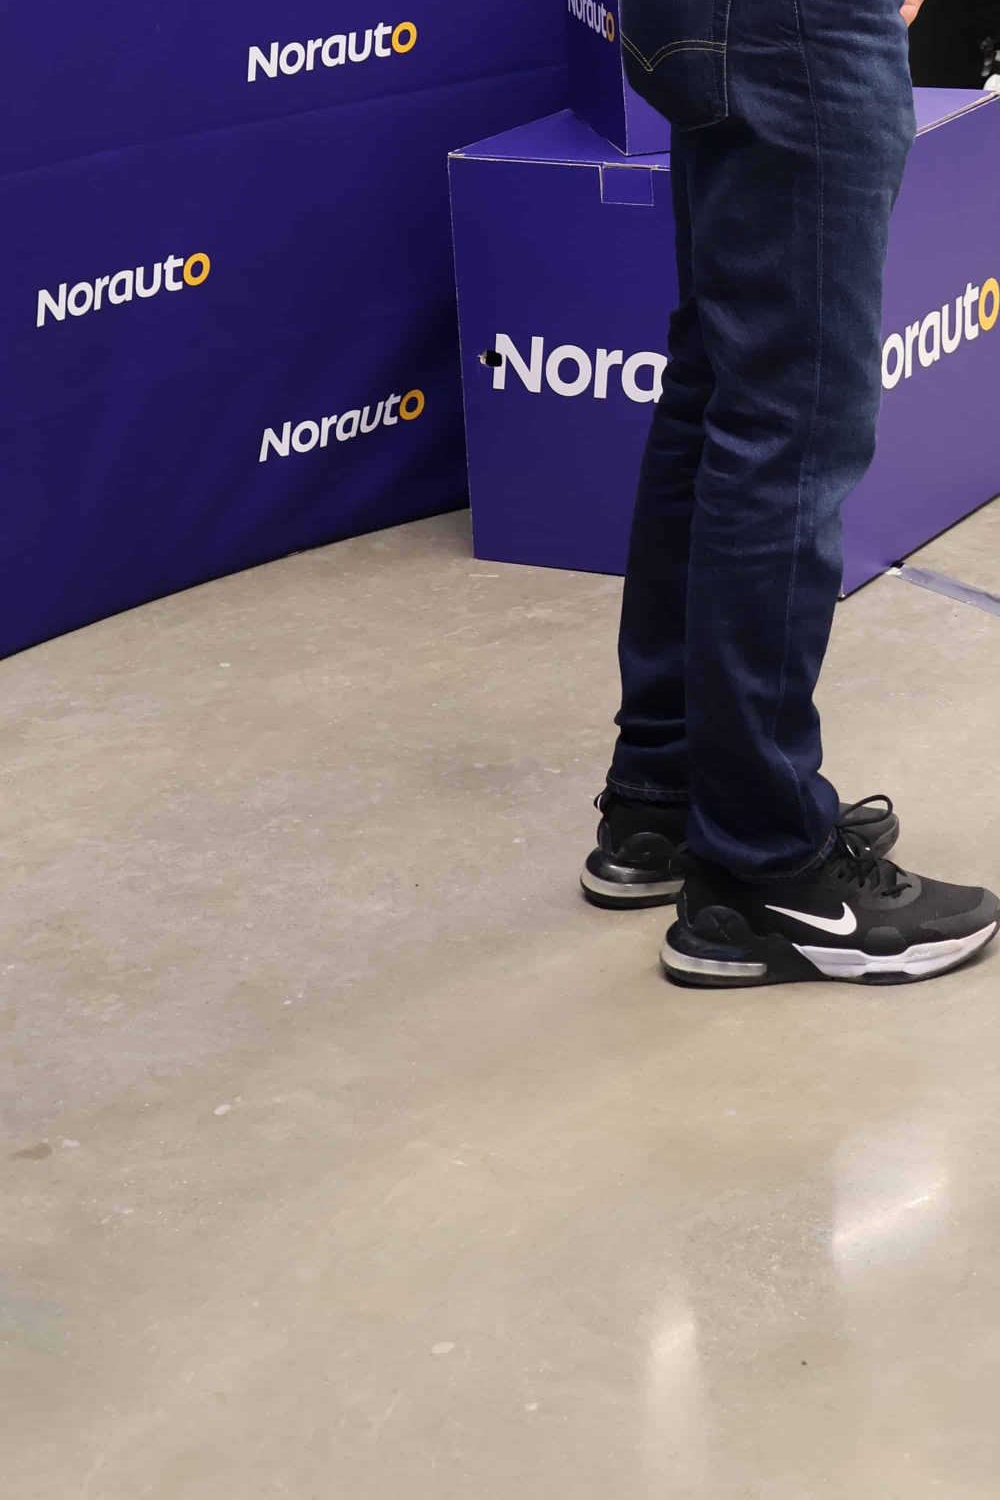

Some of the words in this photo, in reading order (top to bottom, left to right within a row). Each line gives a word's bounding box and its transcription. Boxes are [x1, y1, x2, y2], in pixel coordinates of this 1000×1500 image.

[248, 22, 417, 82] Norauto
[37, 253, 210, 327] Norauto
[492, 334, 668, 404] Nora
[881, 277, 1000, 390] orauto
[259, 390, 424, 462] Norauto
